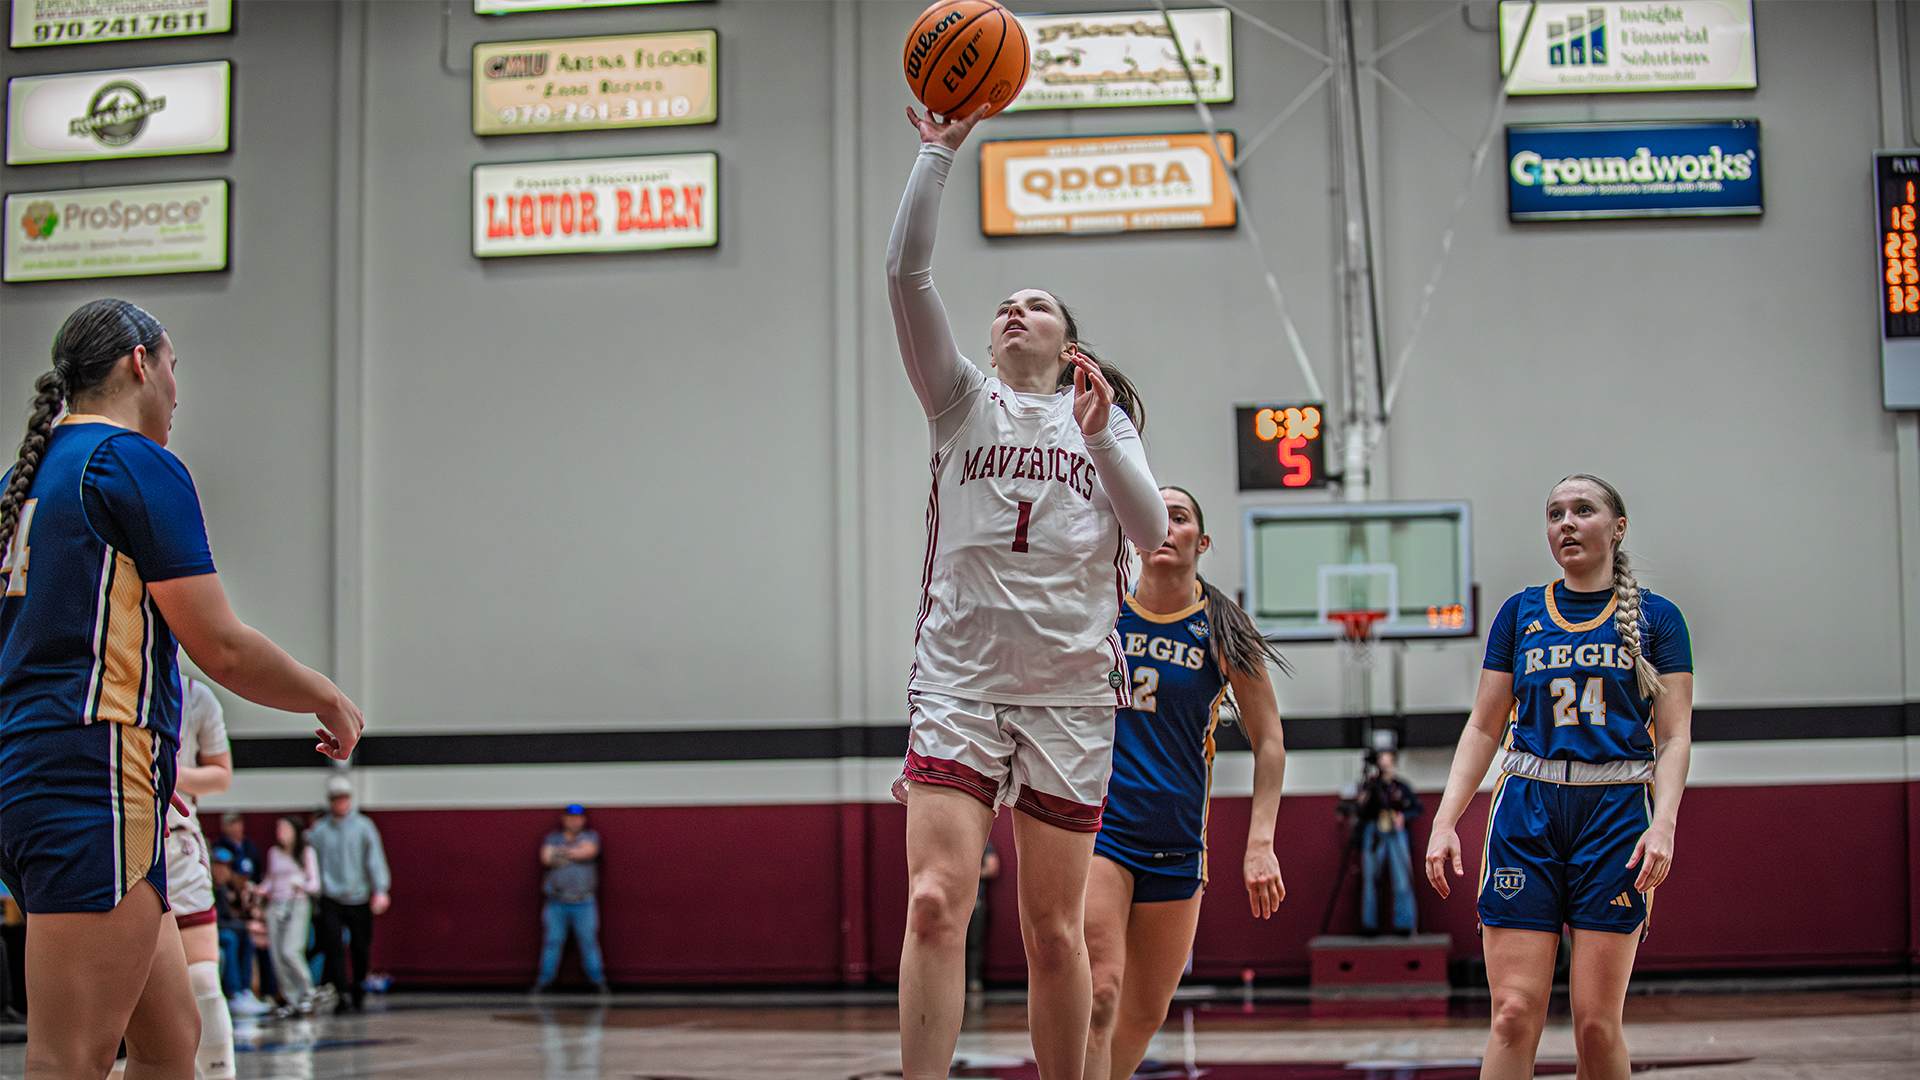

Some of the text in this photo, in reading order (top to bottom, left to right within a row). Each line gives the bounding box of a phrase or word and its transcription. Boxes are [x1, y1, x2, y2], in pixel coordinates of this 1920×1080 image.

[33, 11, 208, 43] 970.241.7611
[1620, 6, 1683, 24] Insight
[1622, 28, 1709, 44] Financial
[486, 53, 548, 79] CMU
[907, 11, 965, 79] Wilson
[942, 42, 979, 93] EVO
[1022, 161, 1191, 203] QDOBA
[1510, 145, 1752, 187] Groundworks
[65, 197, 202, 232] ProSpace
[486, 185, 703, 238] LIQUOR BARN
[1255, 406, 1321, 441] 6:32
[960, 445, 1097, 502] MAVERICKS
[1278, 436, 1312, 487] 5
[1011, 501, 1033, 553] 1
[1525, 643, 1634, 675] REGIS
[1549, 677, 1607, 727] 24
[1493, 874, 1525, 890] RU
